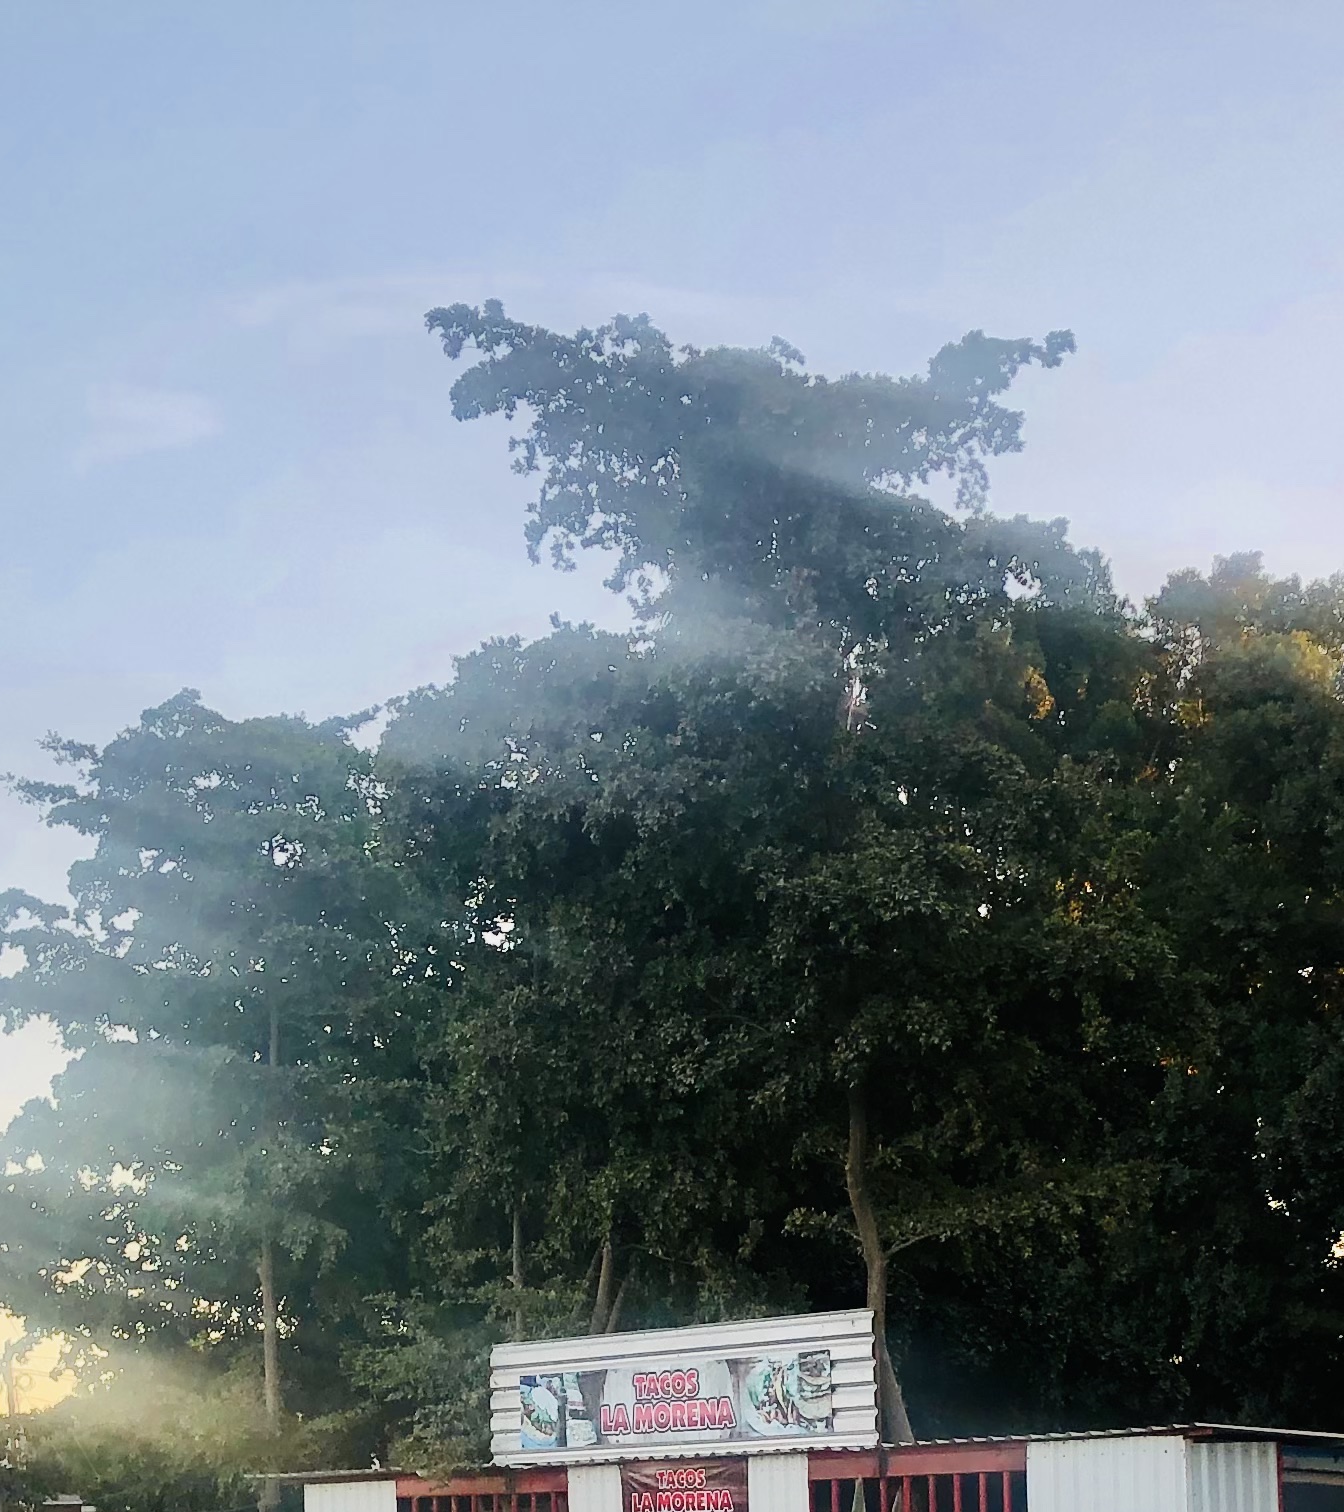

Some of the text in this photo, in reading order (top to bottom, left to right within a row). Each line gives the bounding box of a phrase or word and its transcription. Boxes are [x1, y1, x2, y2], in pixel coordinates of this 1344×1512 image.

[633, 1369, 699, 1400] TACOS
[600, 1397, 737, 1435] LA MORENA
[656, 1468, 707, 1489] TACOS
